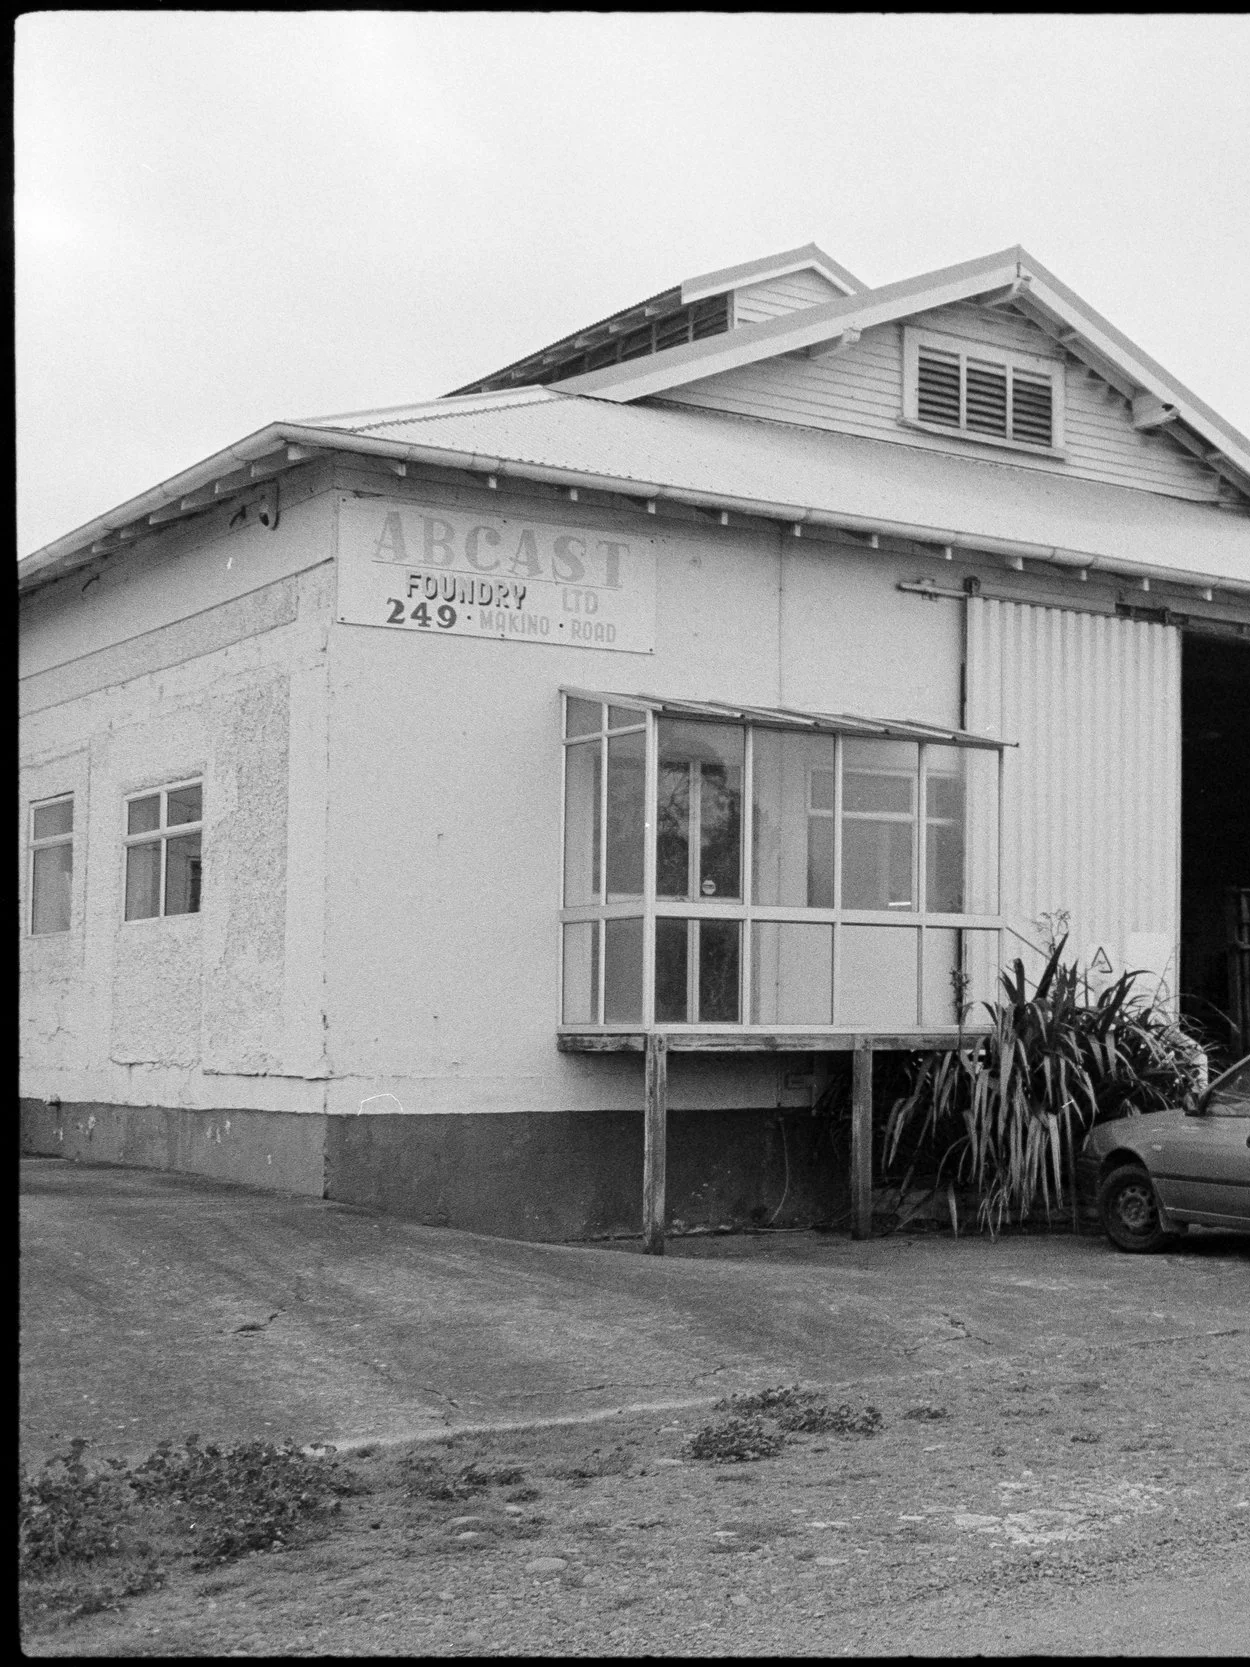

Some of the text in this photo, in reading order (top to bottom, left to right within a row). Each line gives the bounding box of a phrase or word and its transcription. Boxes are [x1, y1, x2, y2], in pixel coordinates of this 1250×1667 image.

[373, 511, 630, 589] ABCAST
[406, 574, 599, 615] FOUNDRY LTD
[386, 597, 617, 643] 249 MAKINO ROAD
